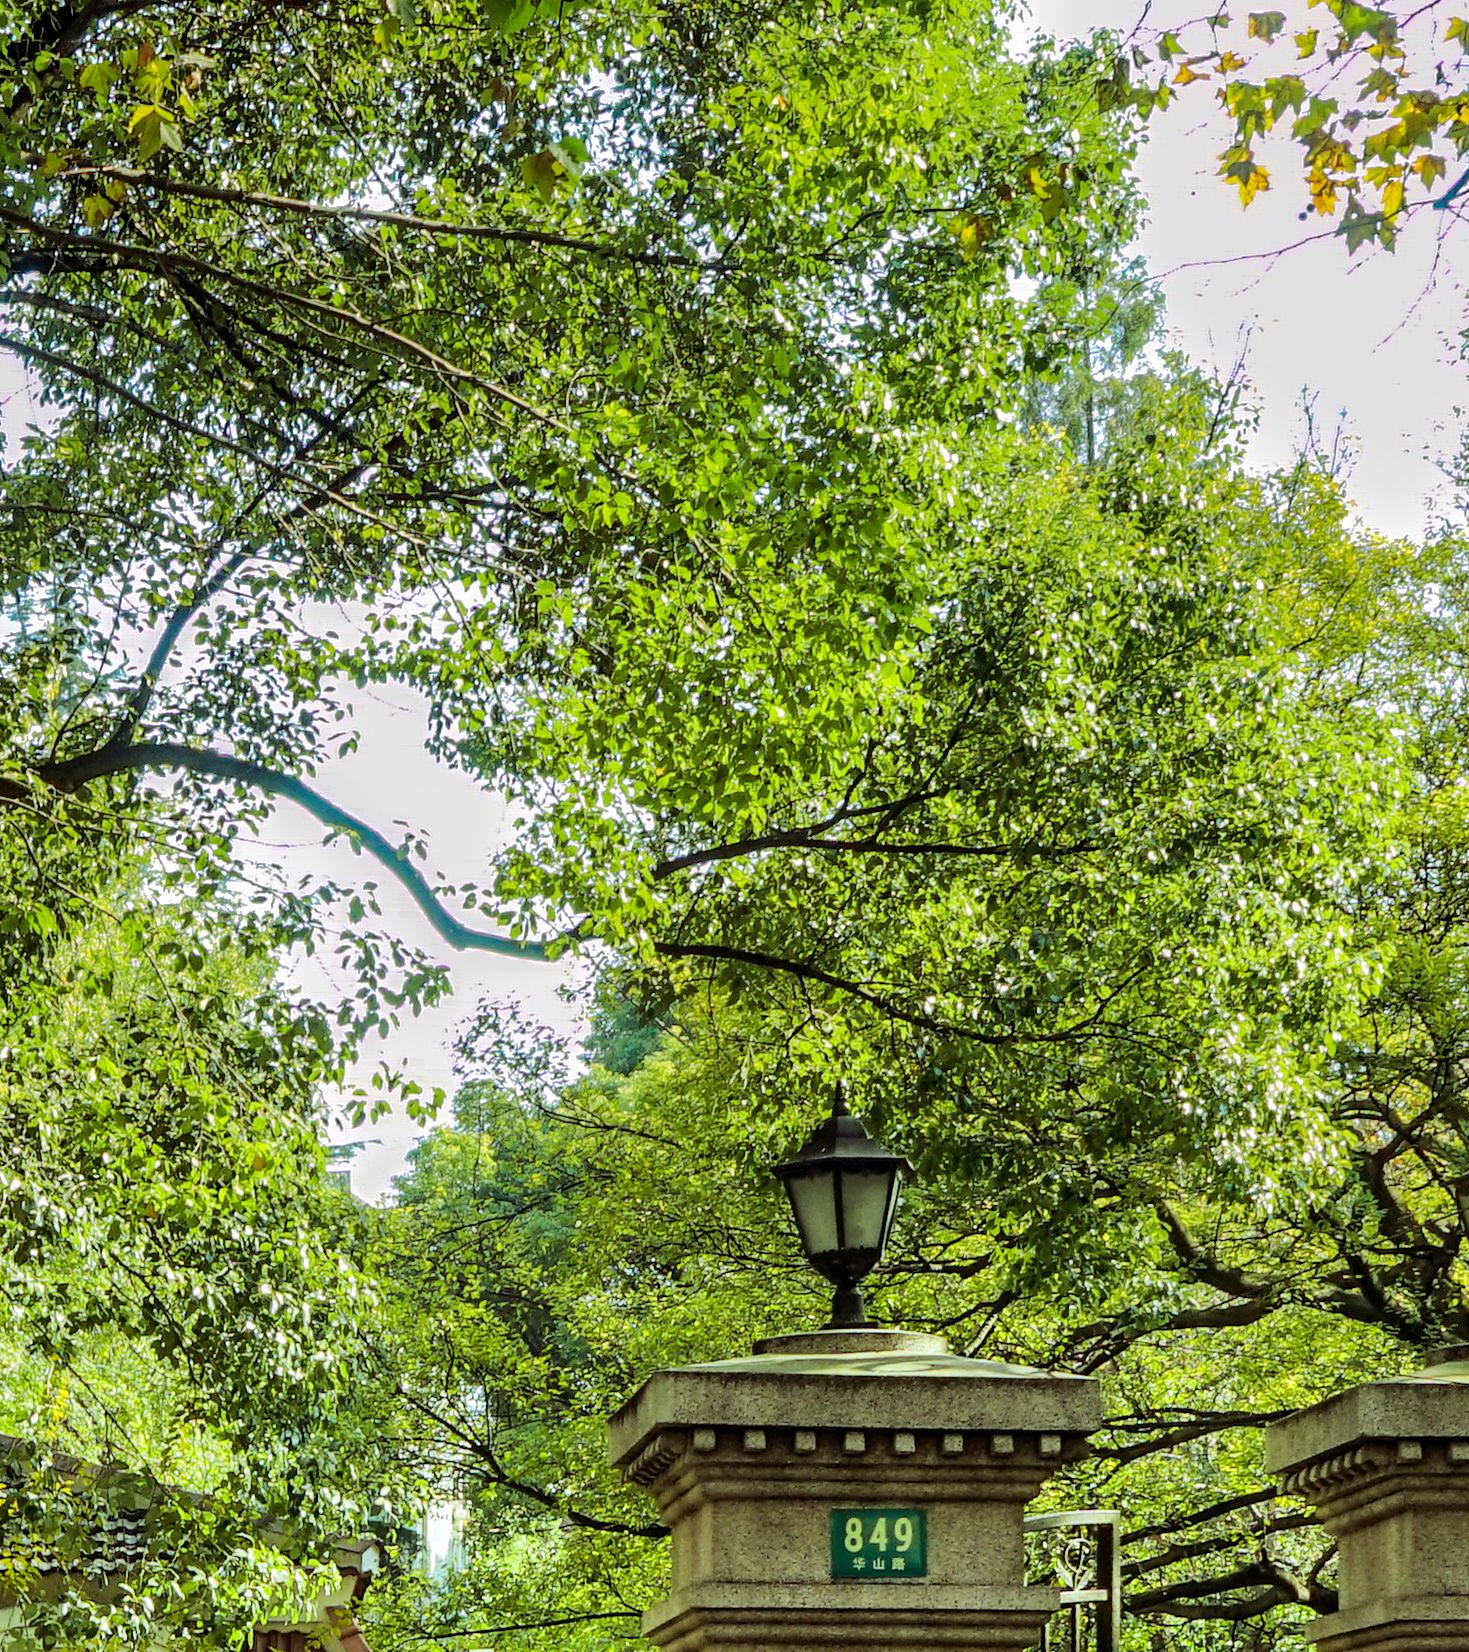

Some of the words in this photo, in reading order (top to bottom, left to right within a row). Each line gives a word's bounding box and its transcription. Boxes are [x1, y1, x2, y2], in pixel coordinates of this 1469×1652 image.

[844, 1517, 913, 1553] 849
[852, 1556, 906, 1571] 华山路
